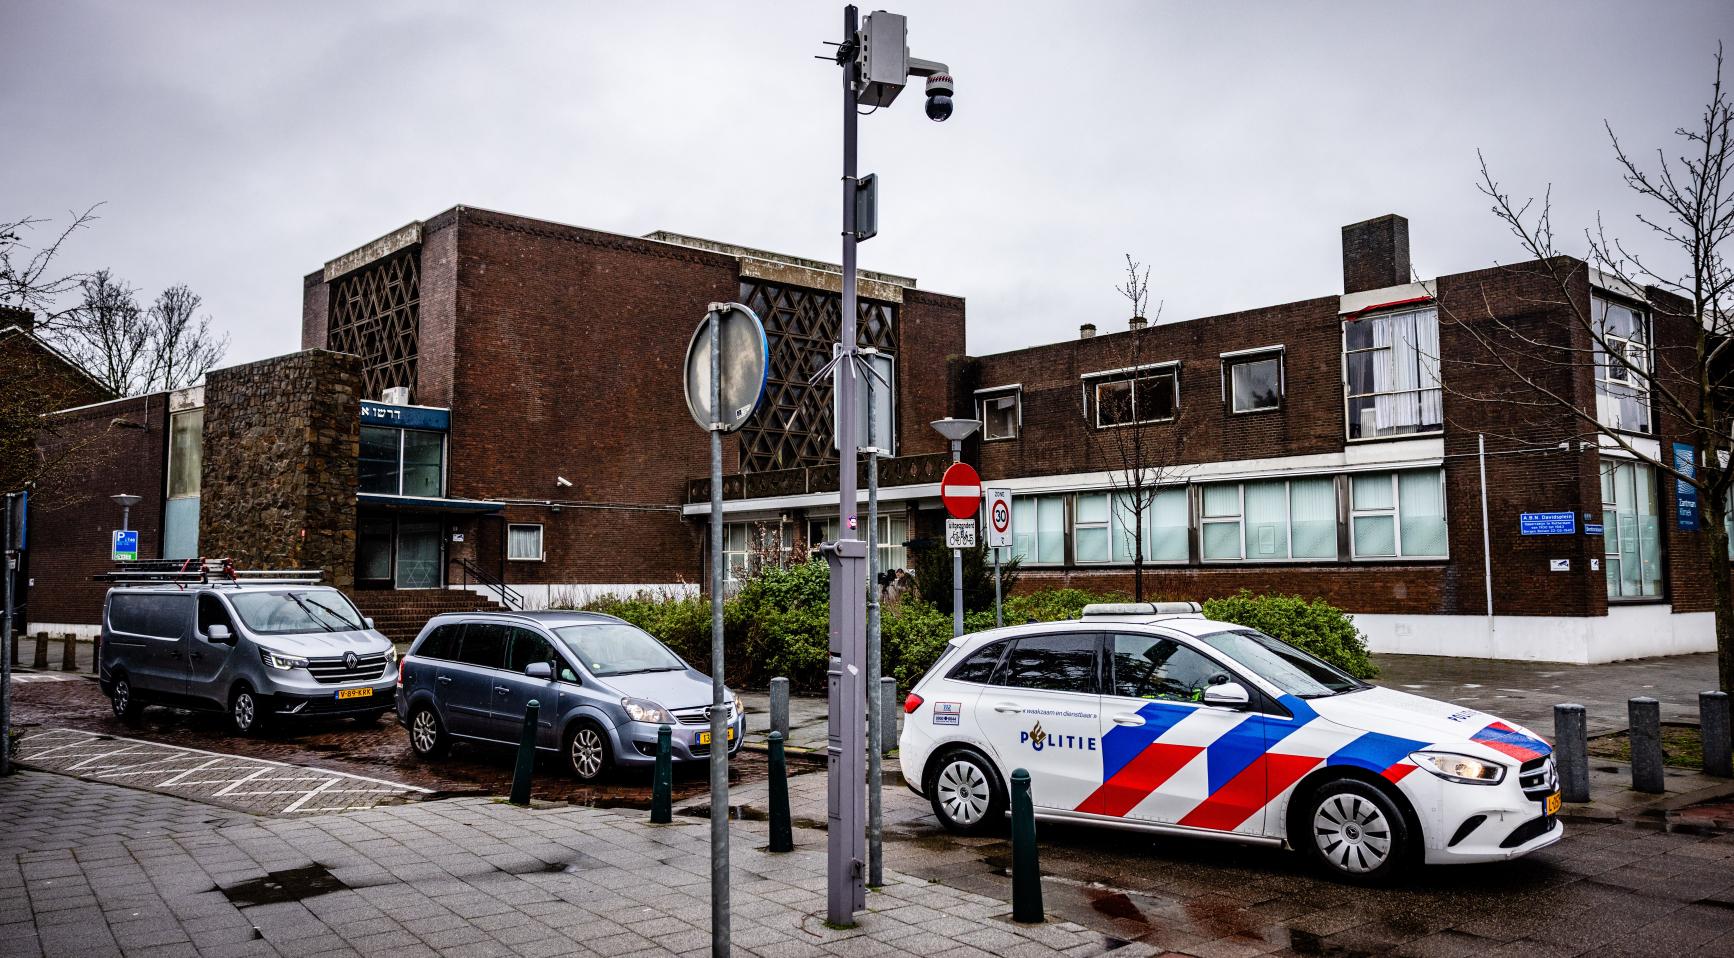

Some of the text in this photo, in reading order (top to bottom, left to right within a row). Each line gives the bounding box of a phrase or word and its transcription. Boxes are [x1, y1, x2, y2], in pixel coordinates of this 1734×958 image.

[372, 407, 401, 420] דרשו
[995, 509, 1006, 523] 30
[1541, 513, 1573, 521] Davidsplein
[117, 532, 126, 542] P
[340, 689, 371, 698] V-89-KRK
[1026, 708, 1055, 716] waakzaam
[1062, 711, 1093, 719] dienstbaar
[1020, 731, 1096, 752] POLITIE
